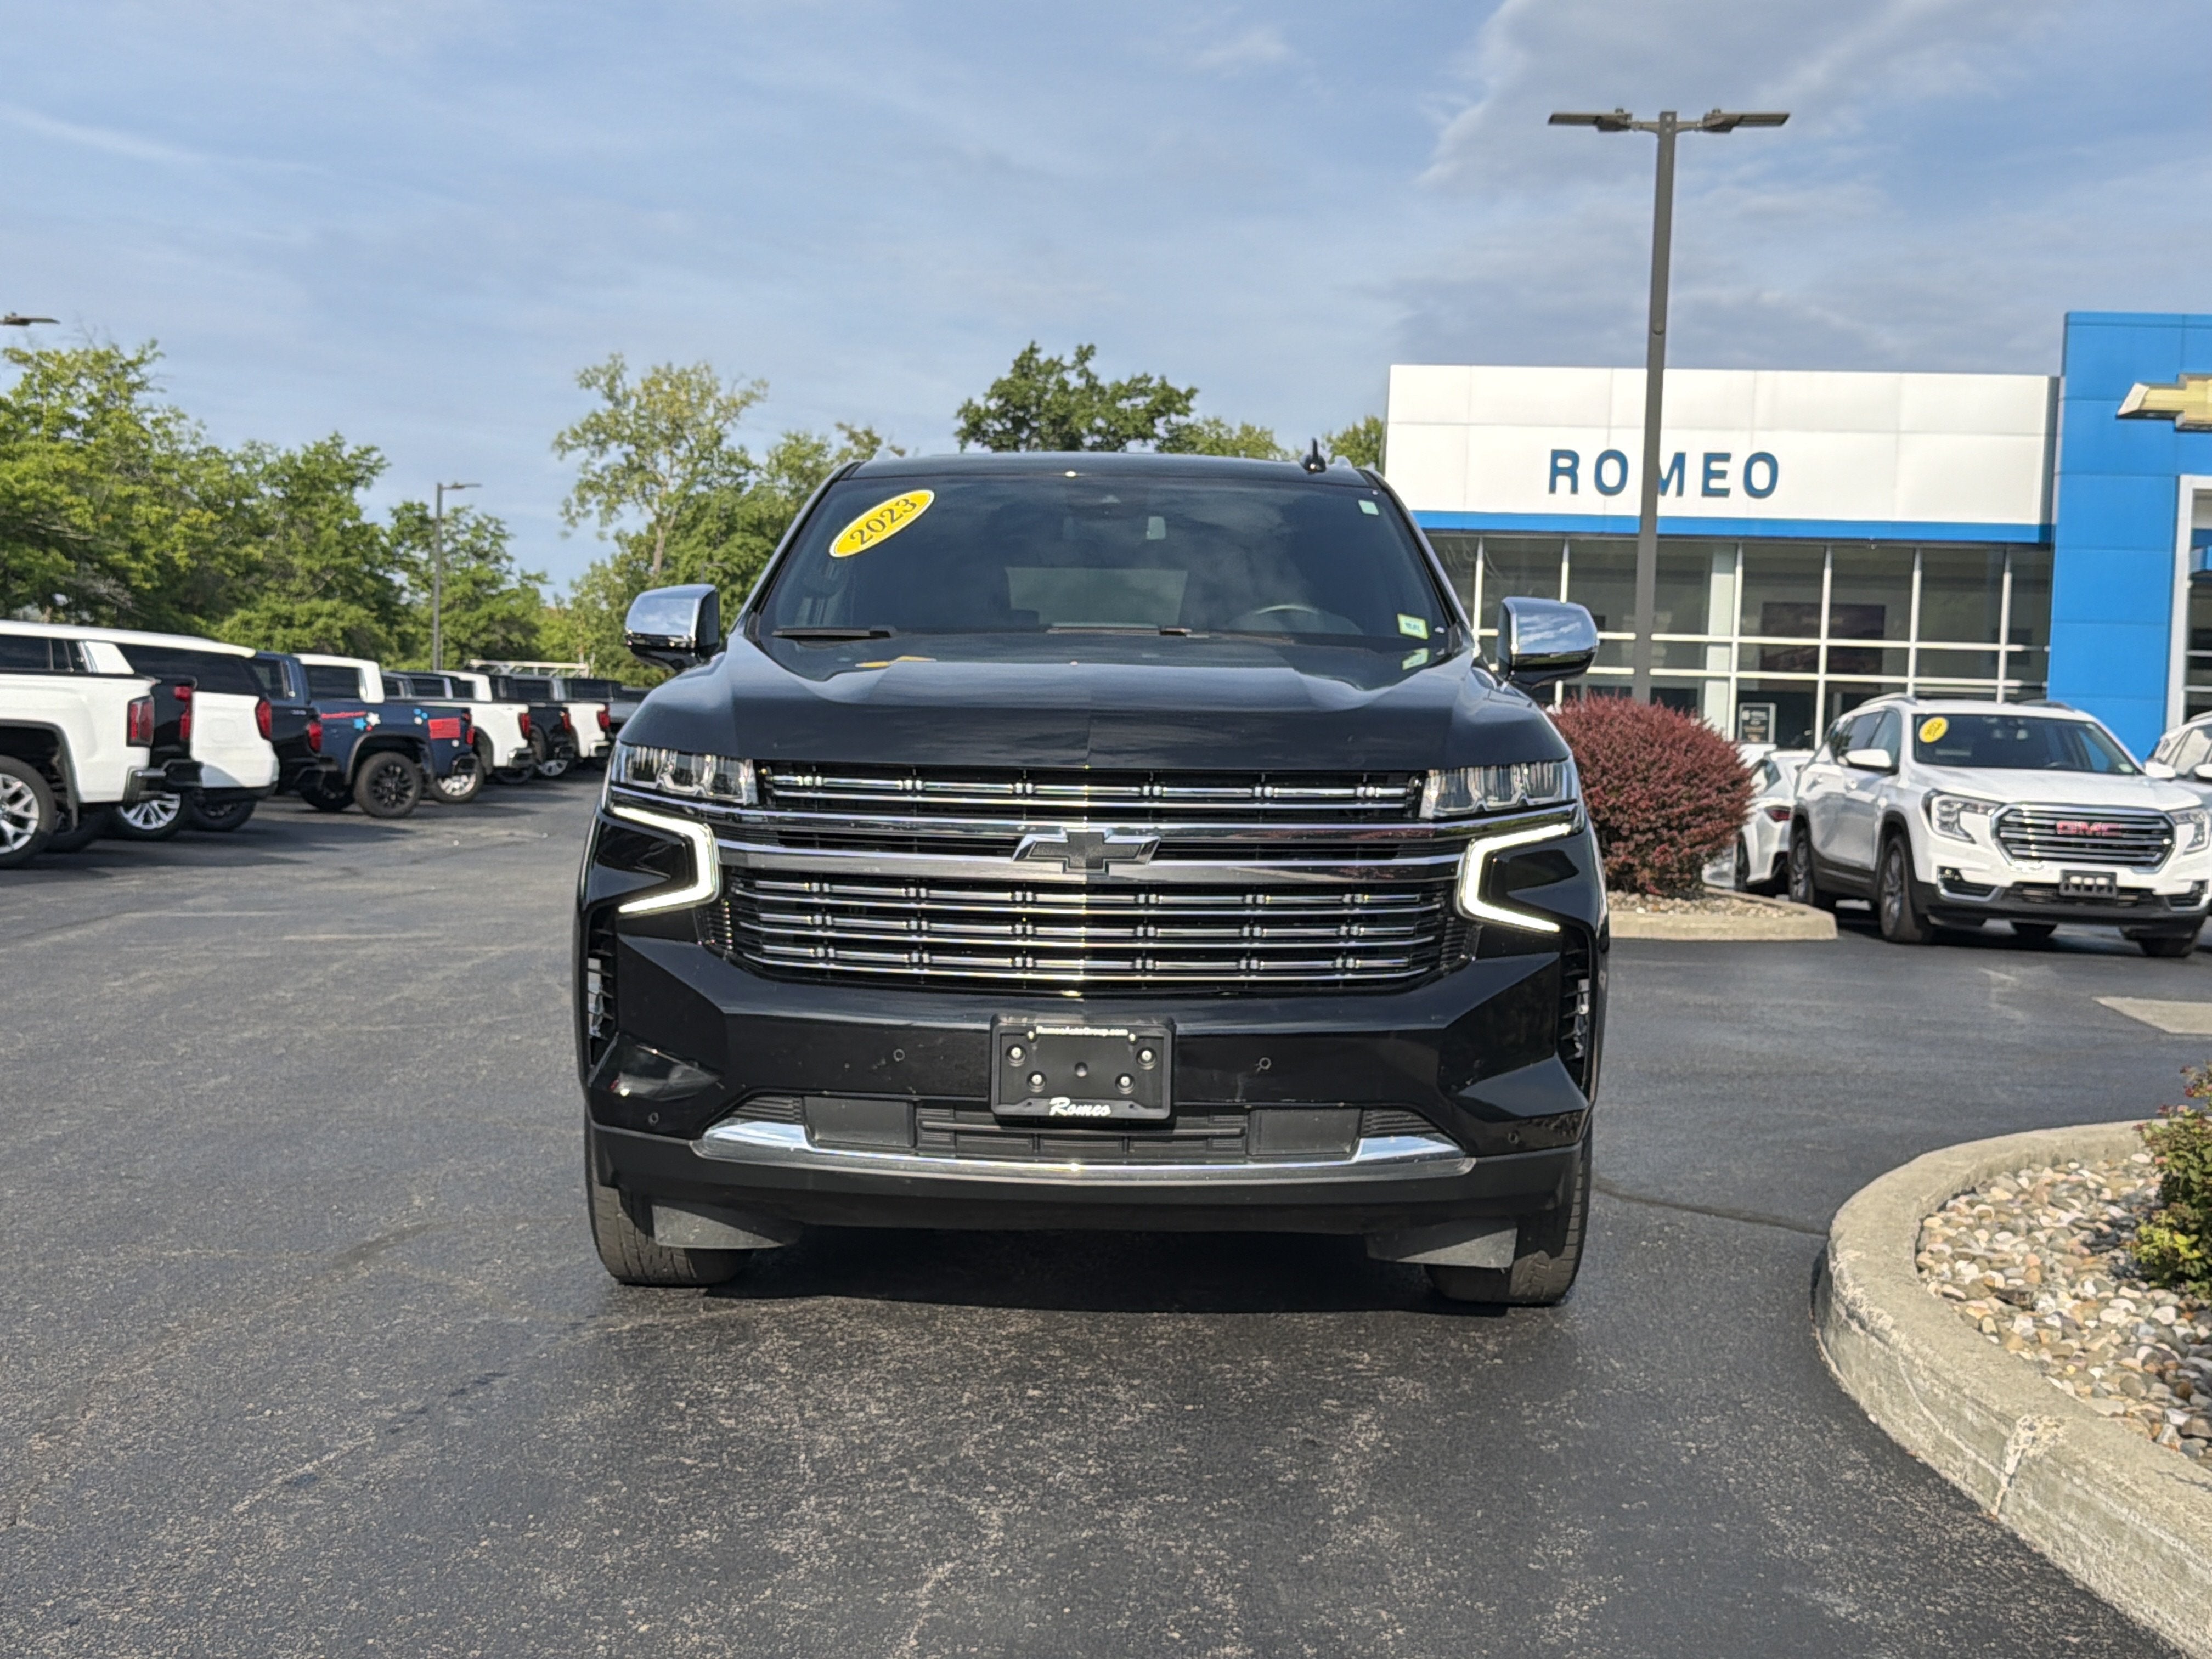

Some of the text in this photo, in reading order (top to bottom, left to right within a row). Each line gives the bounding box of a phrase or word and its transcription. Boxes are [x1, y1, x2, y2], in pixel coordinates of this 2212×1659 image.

[1548, 448, 1779, 499] ROMEO
[850, 498, 917, 545] 2023
[2056, 820, 2123, 837] GMC
[1049, 1096, 1111, 1117] Romeo
